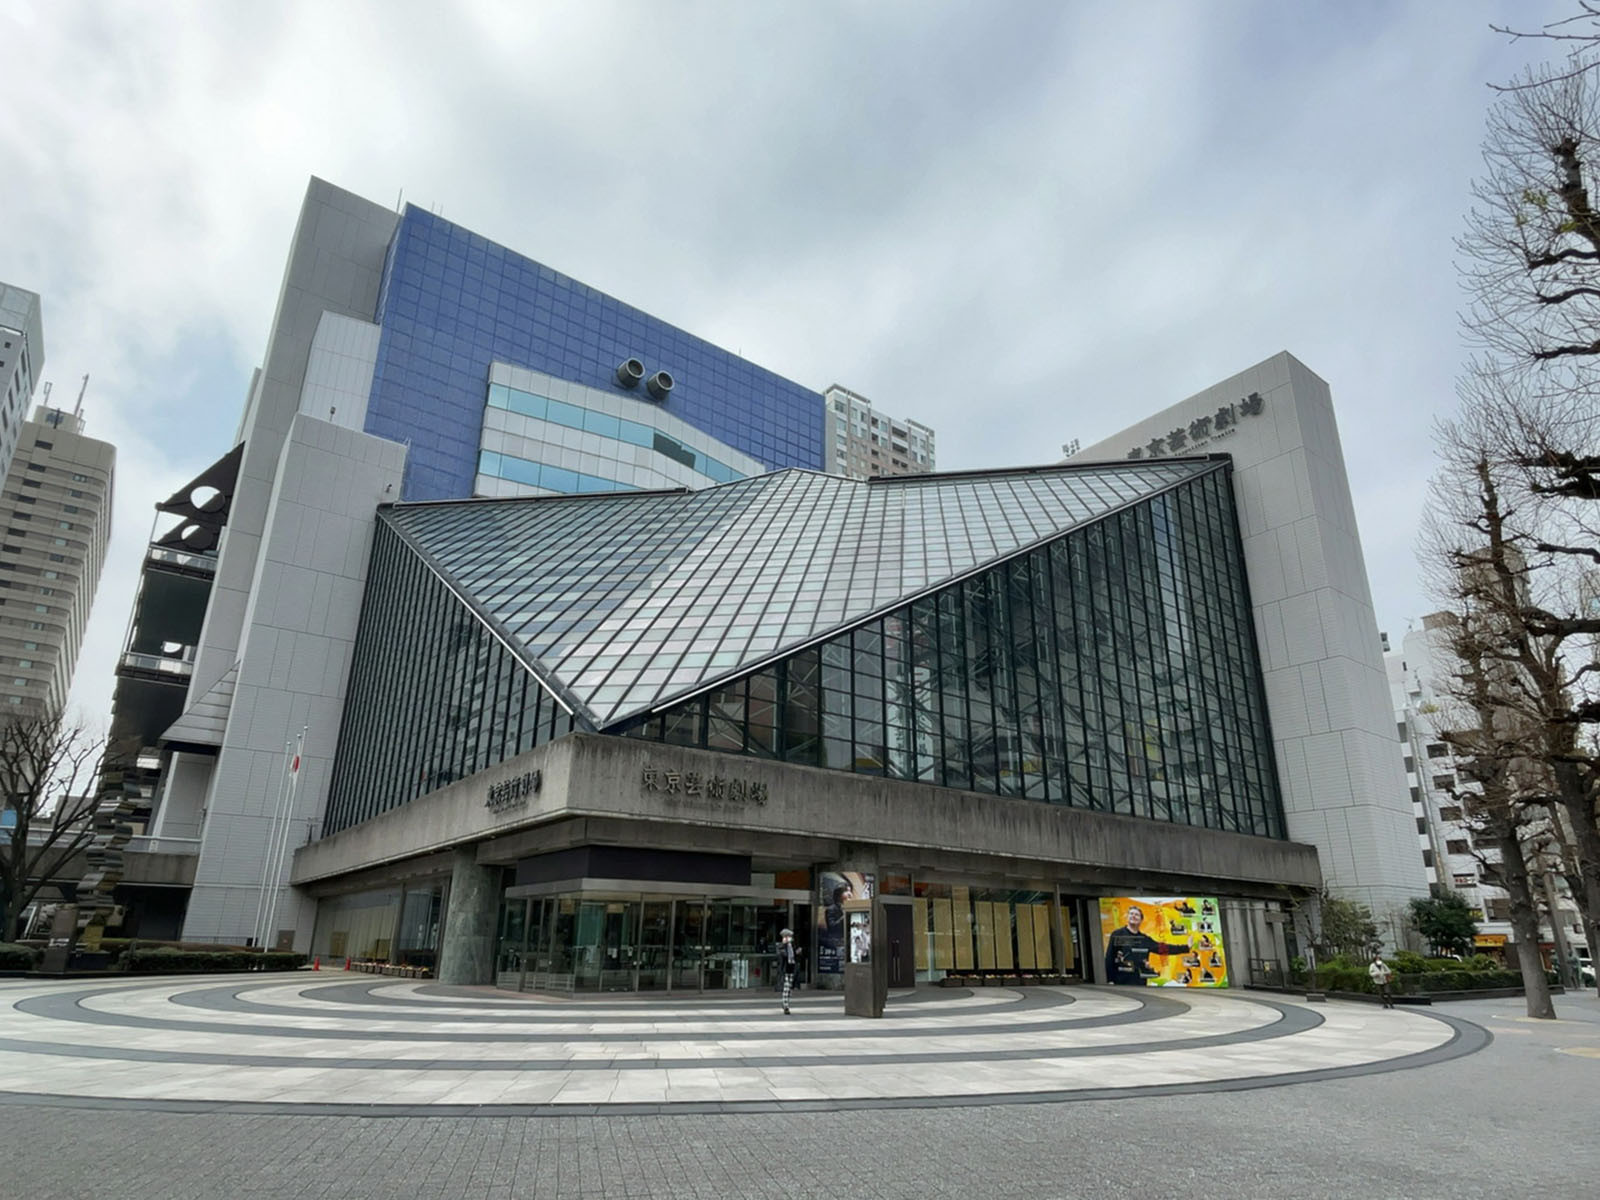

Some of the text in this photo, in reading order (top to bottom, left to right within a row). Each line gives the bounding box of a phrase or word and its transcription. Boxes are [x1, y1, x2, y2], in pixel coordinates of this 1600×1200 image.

[641, 765, 769, 806] 東京芸術劇場
